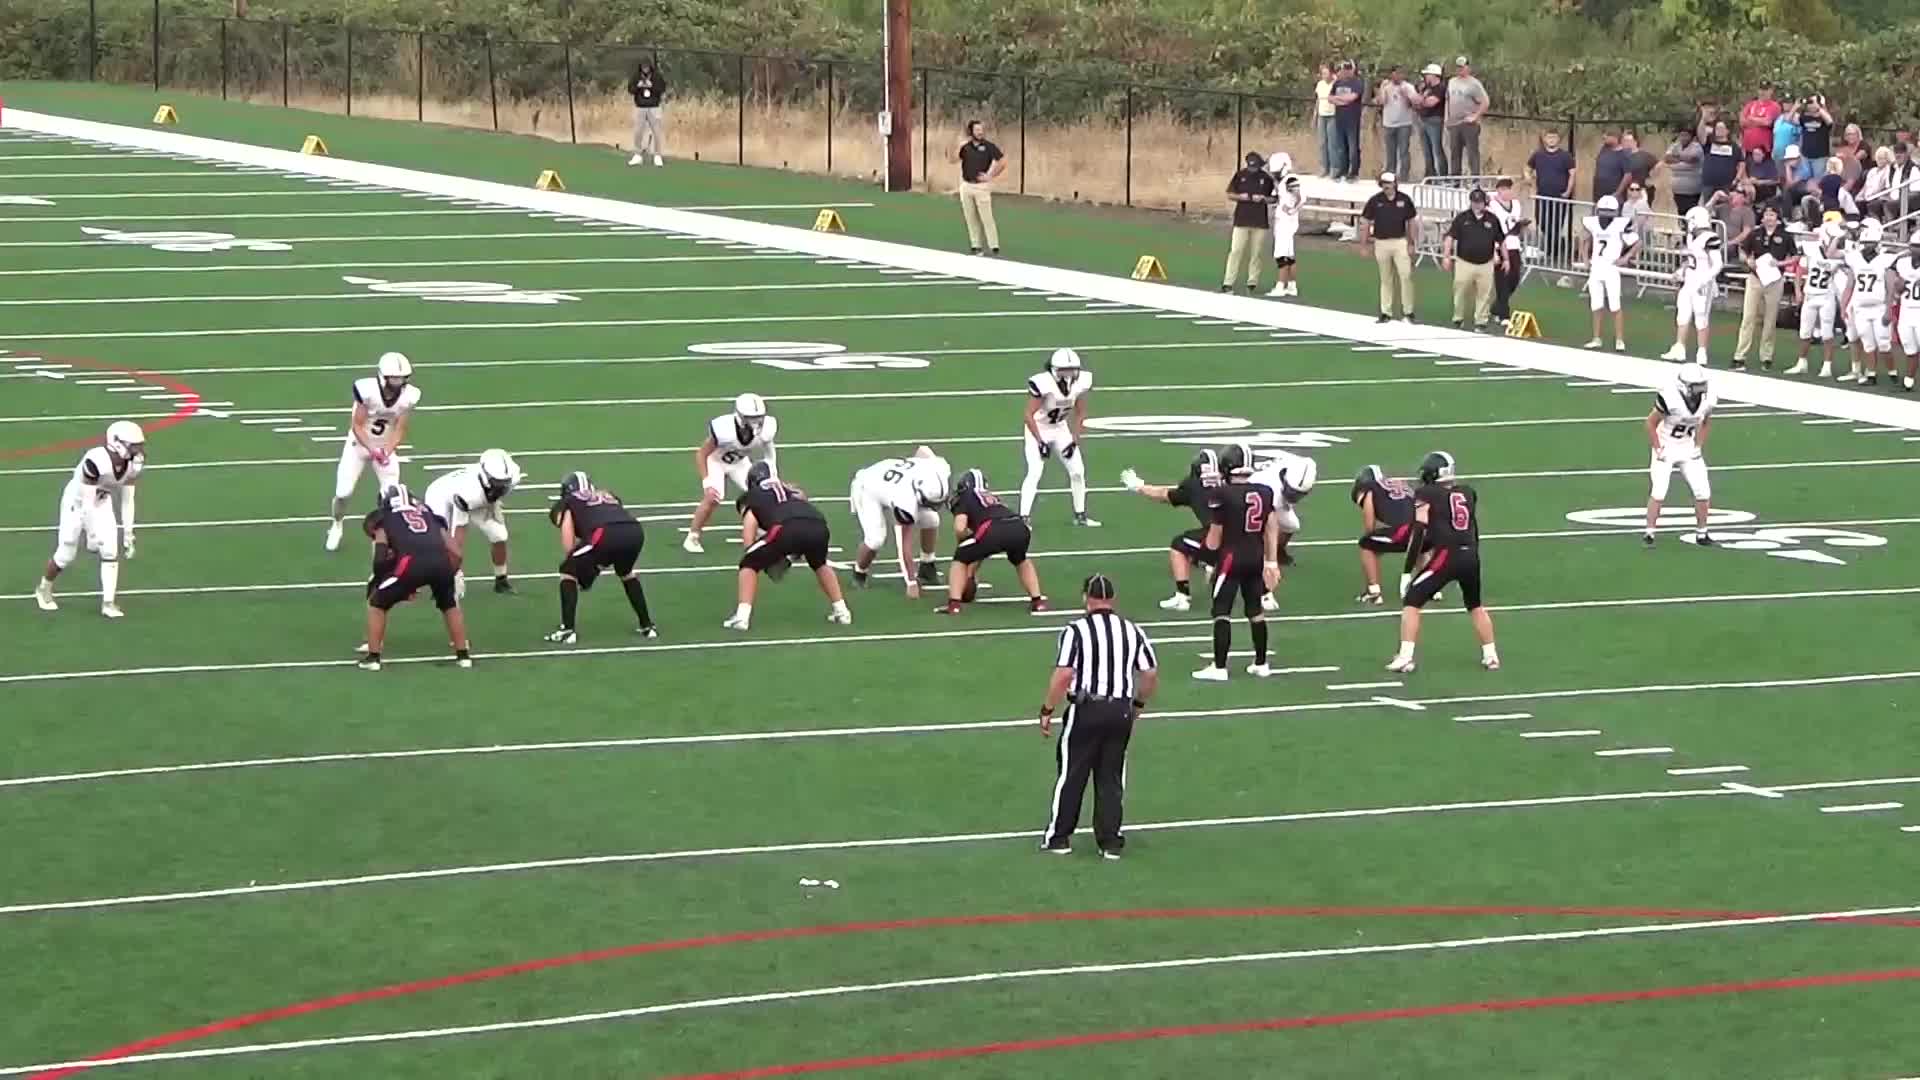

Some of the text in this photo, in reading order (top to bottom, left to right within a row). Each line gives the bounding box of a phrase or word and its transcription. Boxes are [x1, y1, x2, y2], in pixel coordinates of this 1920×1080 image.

[1598, 240, 1608, 257] 7
[1809, 267, 1832, 289] 22
[1857, 274, 1878, 293] 57
[371, 418, 388, 436] 5
[401, 510, 428, 533] 5
[1245, 491, 1263, 532] 2
[1449, 492, 1470, 531] 6
